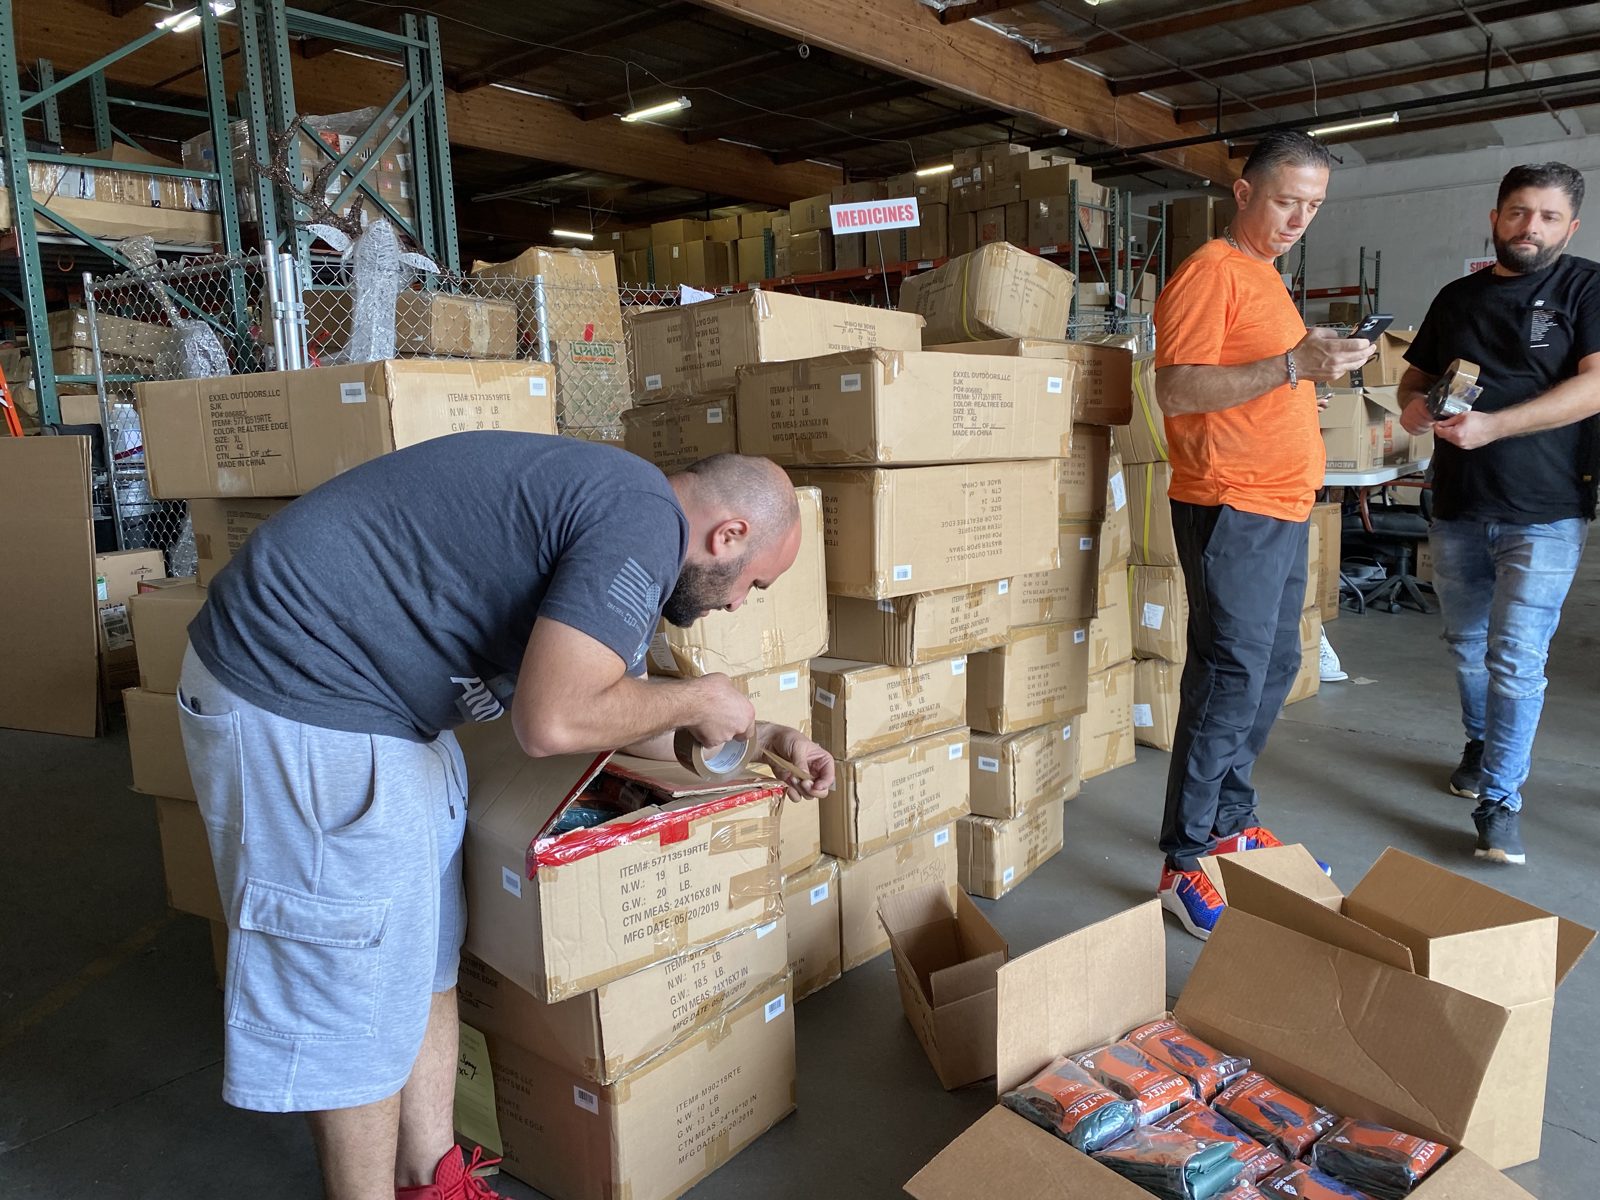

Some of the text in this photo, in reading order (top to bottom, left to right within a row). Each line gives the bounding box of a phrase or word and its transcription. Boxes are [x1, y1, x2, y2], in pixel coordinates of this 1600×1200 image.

[836, 204, 915, 228] MEDICINES
[1470, 260, 1494, 272] SUR
[209, 394, 229, 402] EXXEL
[210, 403, 222, 411] SJK
[237, 423, 270, 433] REALTREE
[270, 422, 289, 431] EDGE
[476, 421, 484, 430] 20
[234, 435, 242, 443] XL
[250, 450, 260, 458] OF
[217, 460, 237, 468] MADE
[245, 459, 266, 467] CHINA
[941, 520, 956, 528] EDGE
[619, 842, 709, 879] ITEM#: 57713519RTE
[620, 863, 692, 895] N.W.: 19 LB.
[621, 880, 693, 912] G.W.: 20 LB.
[622, 882, 721, 927] CTN MEAS: 24X16X8 IN
[623, 901, 720, 945] MFG DATE: 05/20/2019
[692, 959, 706, 974] 17.5
[694, 976, 708, 989] 18.5
[672, 1004, 688, 1019] CTN
[713, 972, 740, 995] 24X16X7
[741, 966, 749, 976] IN
[672, 1016, 689, 1033] MFG
[697, 1103, 705, 1113] 10
[709, 1094, 719, 1105] LB
[1069, 1092, 1114, 1116] AINTEK
[678, 1136, 694, 1152] CTN
[749, 1093, 757, 1103] IN
[697, 1116, 705, 1126] 13
[710, 1106, 720, 1118] LB
[678, 1148, 696, 1165] MFG
